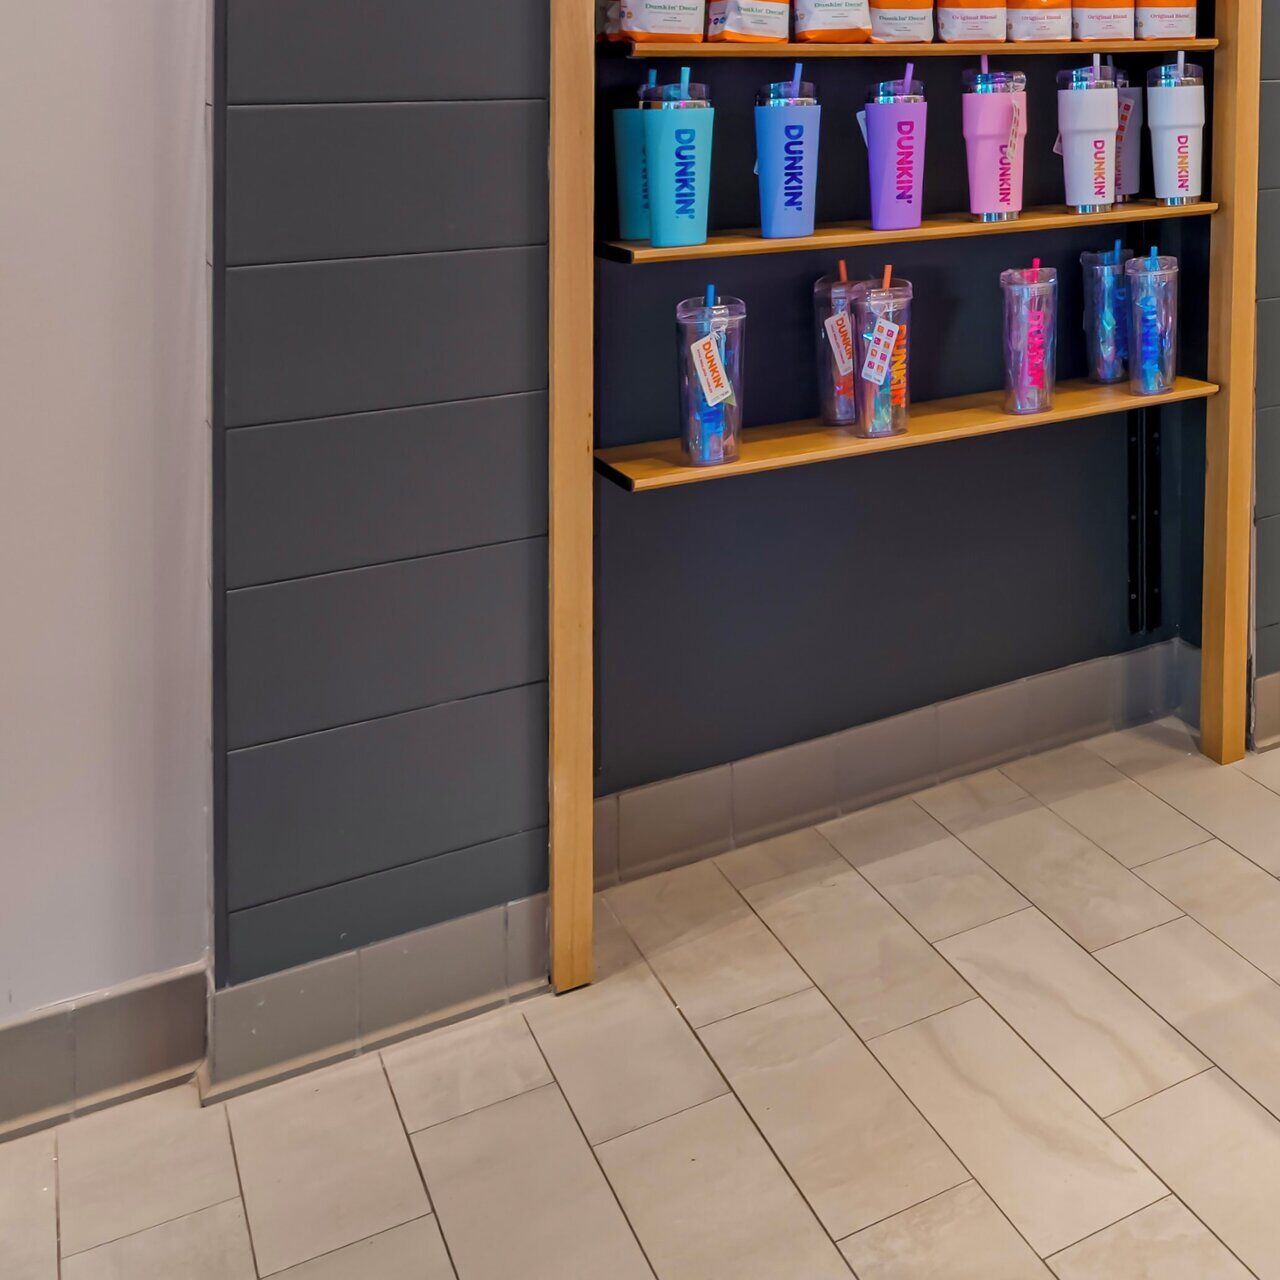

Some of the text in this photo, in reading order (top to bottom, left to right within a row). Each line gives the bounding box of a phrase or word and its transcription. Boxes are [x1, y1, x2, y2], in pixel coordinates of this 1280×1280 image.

[675, 128, 696, 220] DUNKIN'
[784, 124, 804, 212] DUNKIN'
[896, 120, 915, 205] DUNKIN'
[1093, 139, 1105, 198] DUNKIN'
[1177, 134, 1189, 192] DUNKIN'
